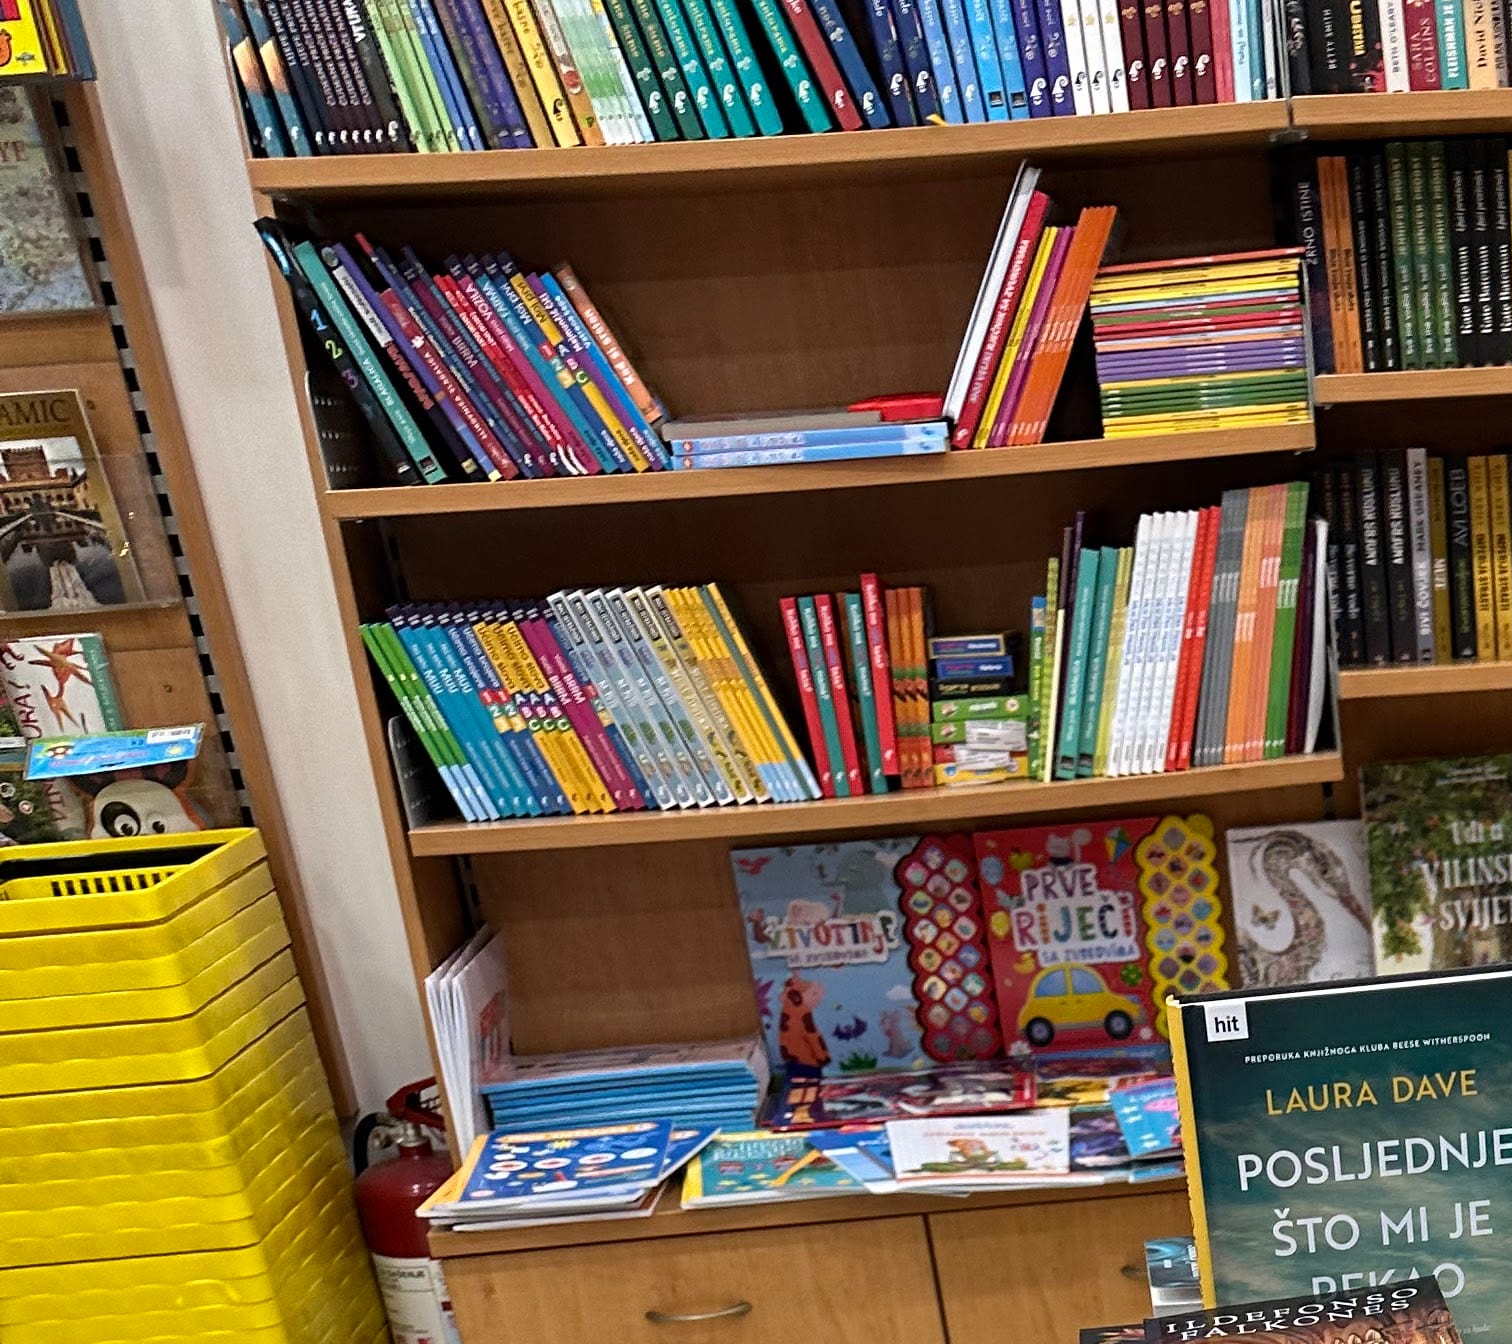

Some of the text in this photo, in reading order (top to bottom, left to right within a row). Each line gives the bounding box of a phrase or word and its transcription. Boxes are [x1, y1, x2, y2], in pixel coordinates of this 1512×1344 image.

[1424, 17, 1438, 83] COLLINS
[1477, 34, 1488, 69] David
[324, 338, 344, 361] 2
[1023, 868, 1096, 900] PRVE
[1214, 1015, 1240, 1033] hit
[1244, 1033, 1491, 1064] PREPORUKA KNJIŽNOGA KLUBA REESE WITHERSPOON
[1265, 1070, 1478, 1116] LAURA DAVE
[1271, 1200, 1494, 1258] ŠTO MI JE
[1166, 1286, 1419, 1335] ILDEFONSO
[1180, 1301, 1411, 1342] FALKONES
